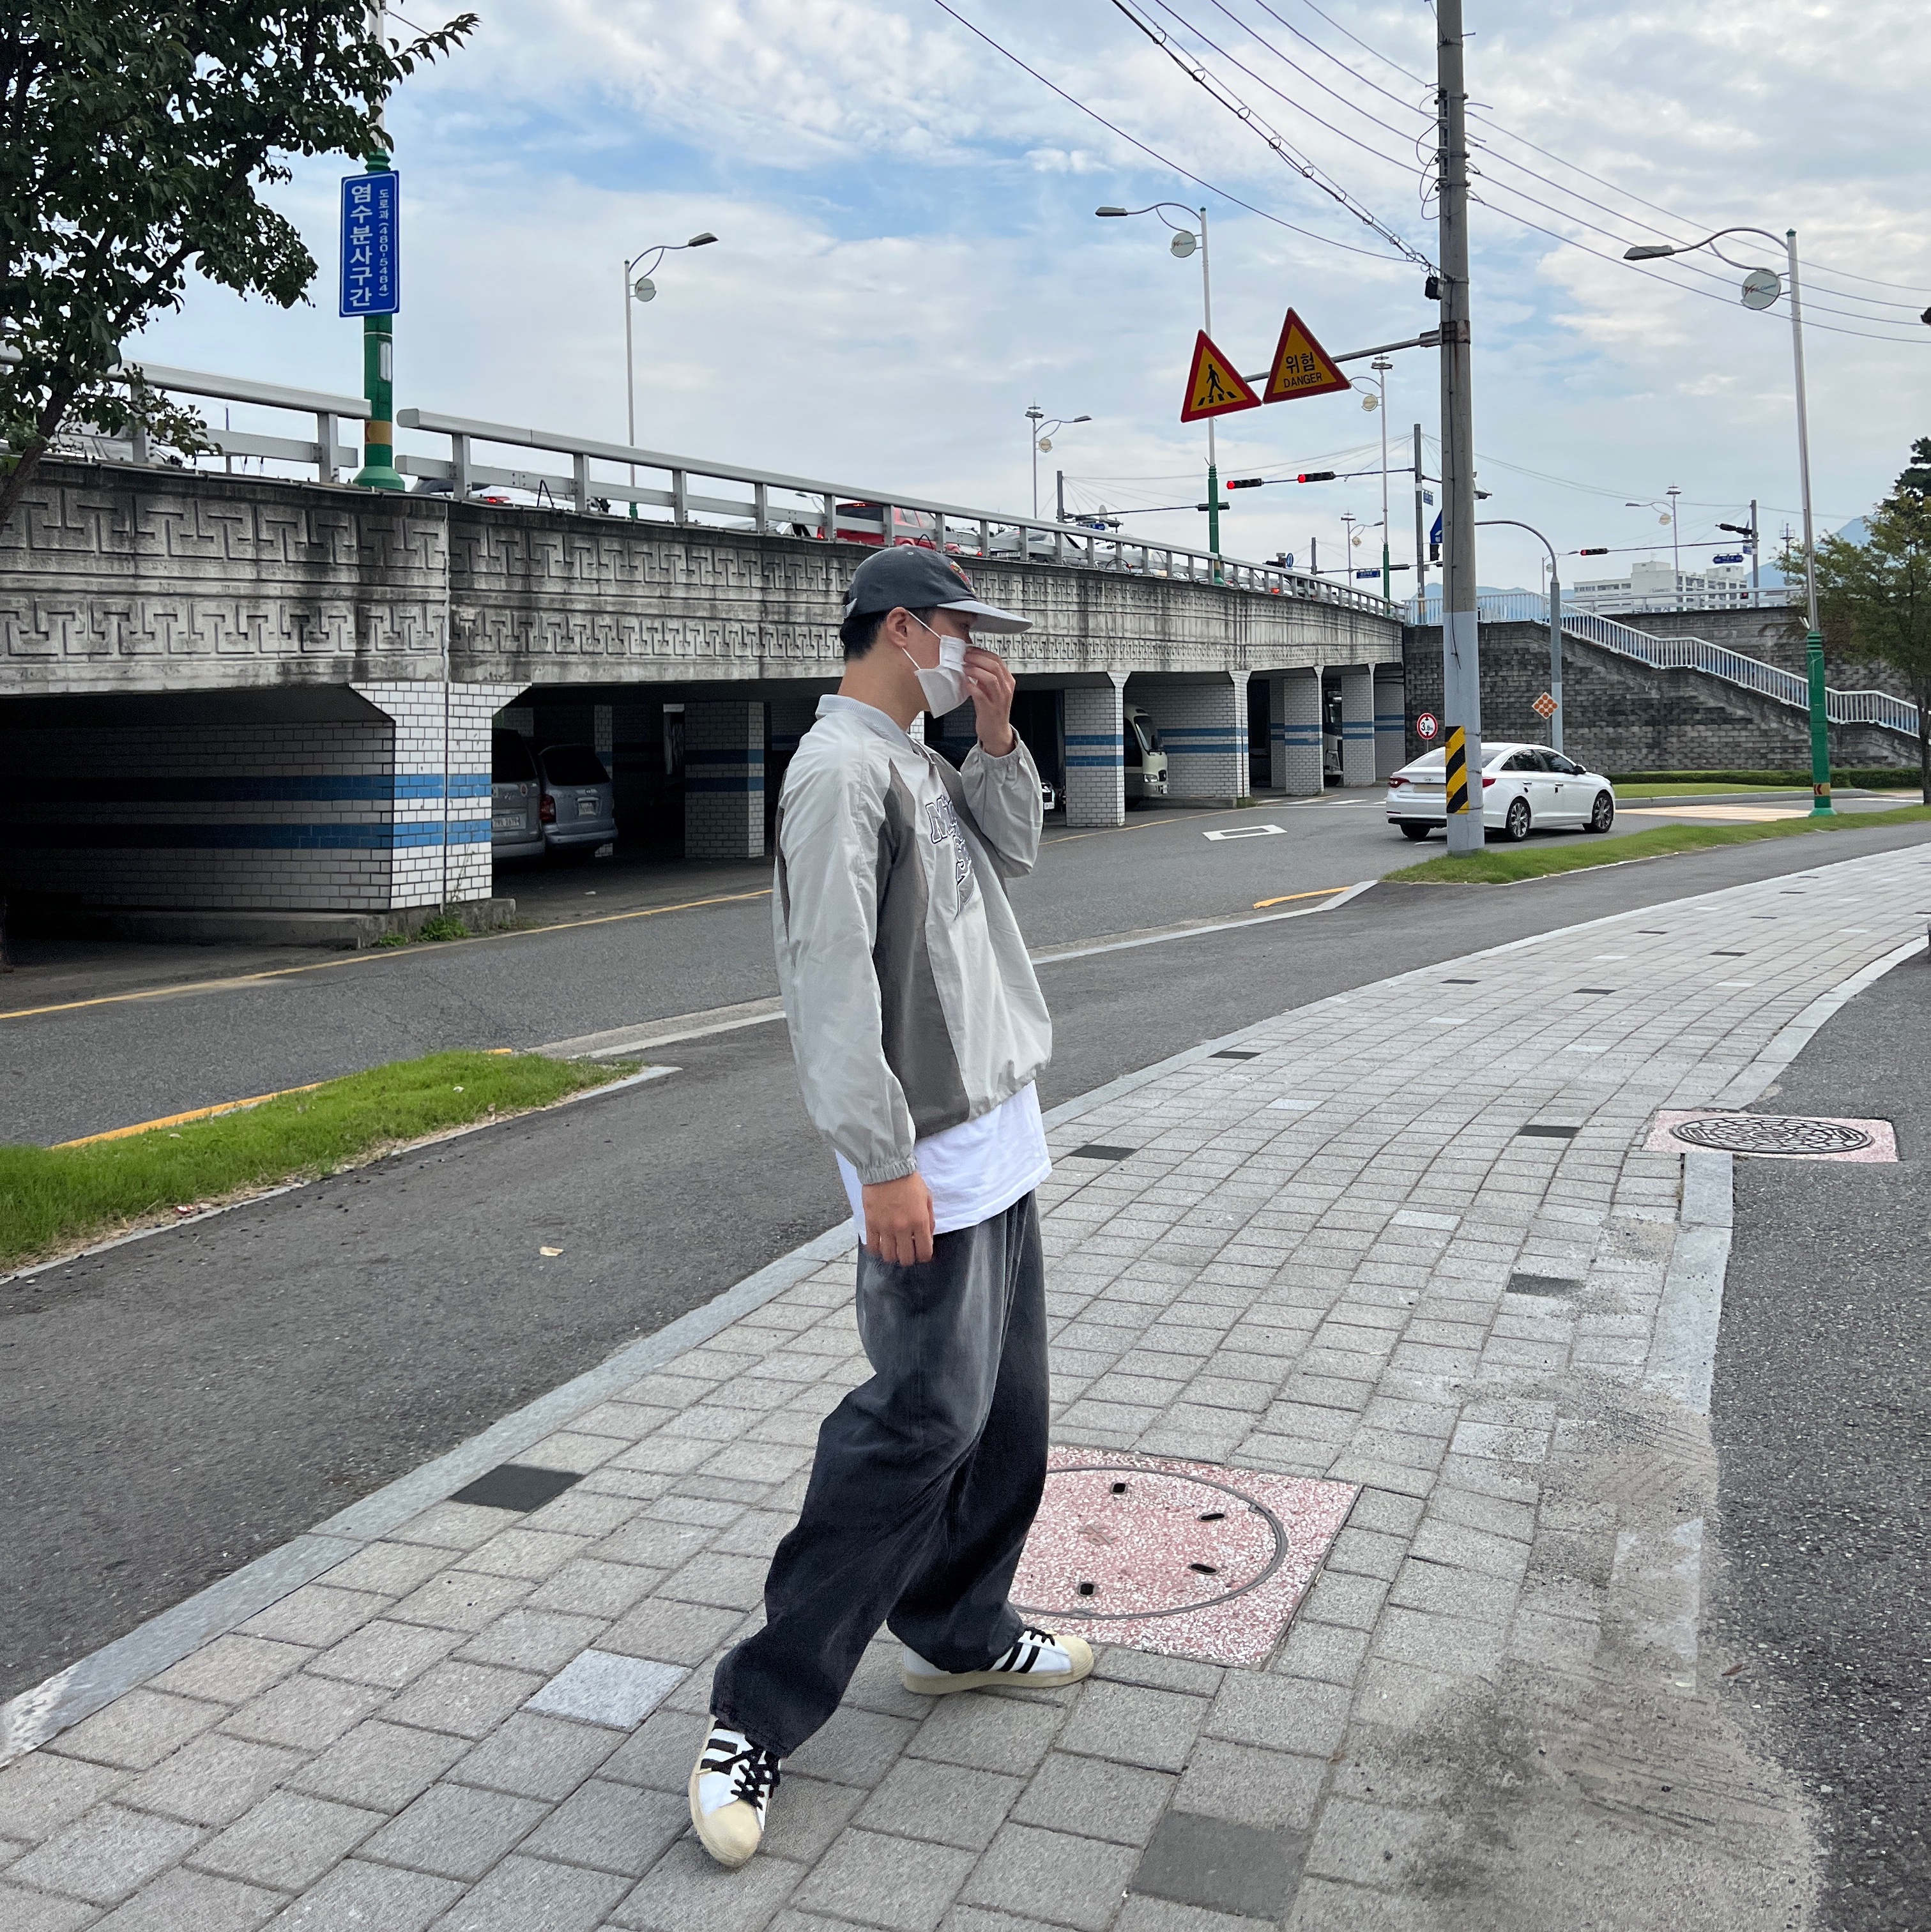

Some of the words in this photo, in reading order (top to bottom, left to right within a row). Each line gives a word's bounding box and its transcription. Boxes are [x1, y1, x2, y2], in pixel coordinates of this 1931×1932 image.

[349, 183, 373, 307] 염수분사구간
[1285, 351, 1315, 374] 위험
[1283, 372, 1323, 388] DANGER
